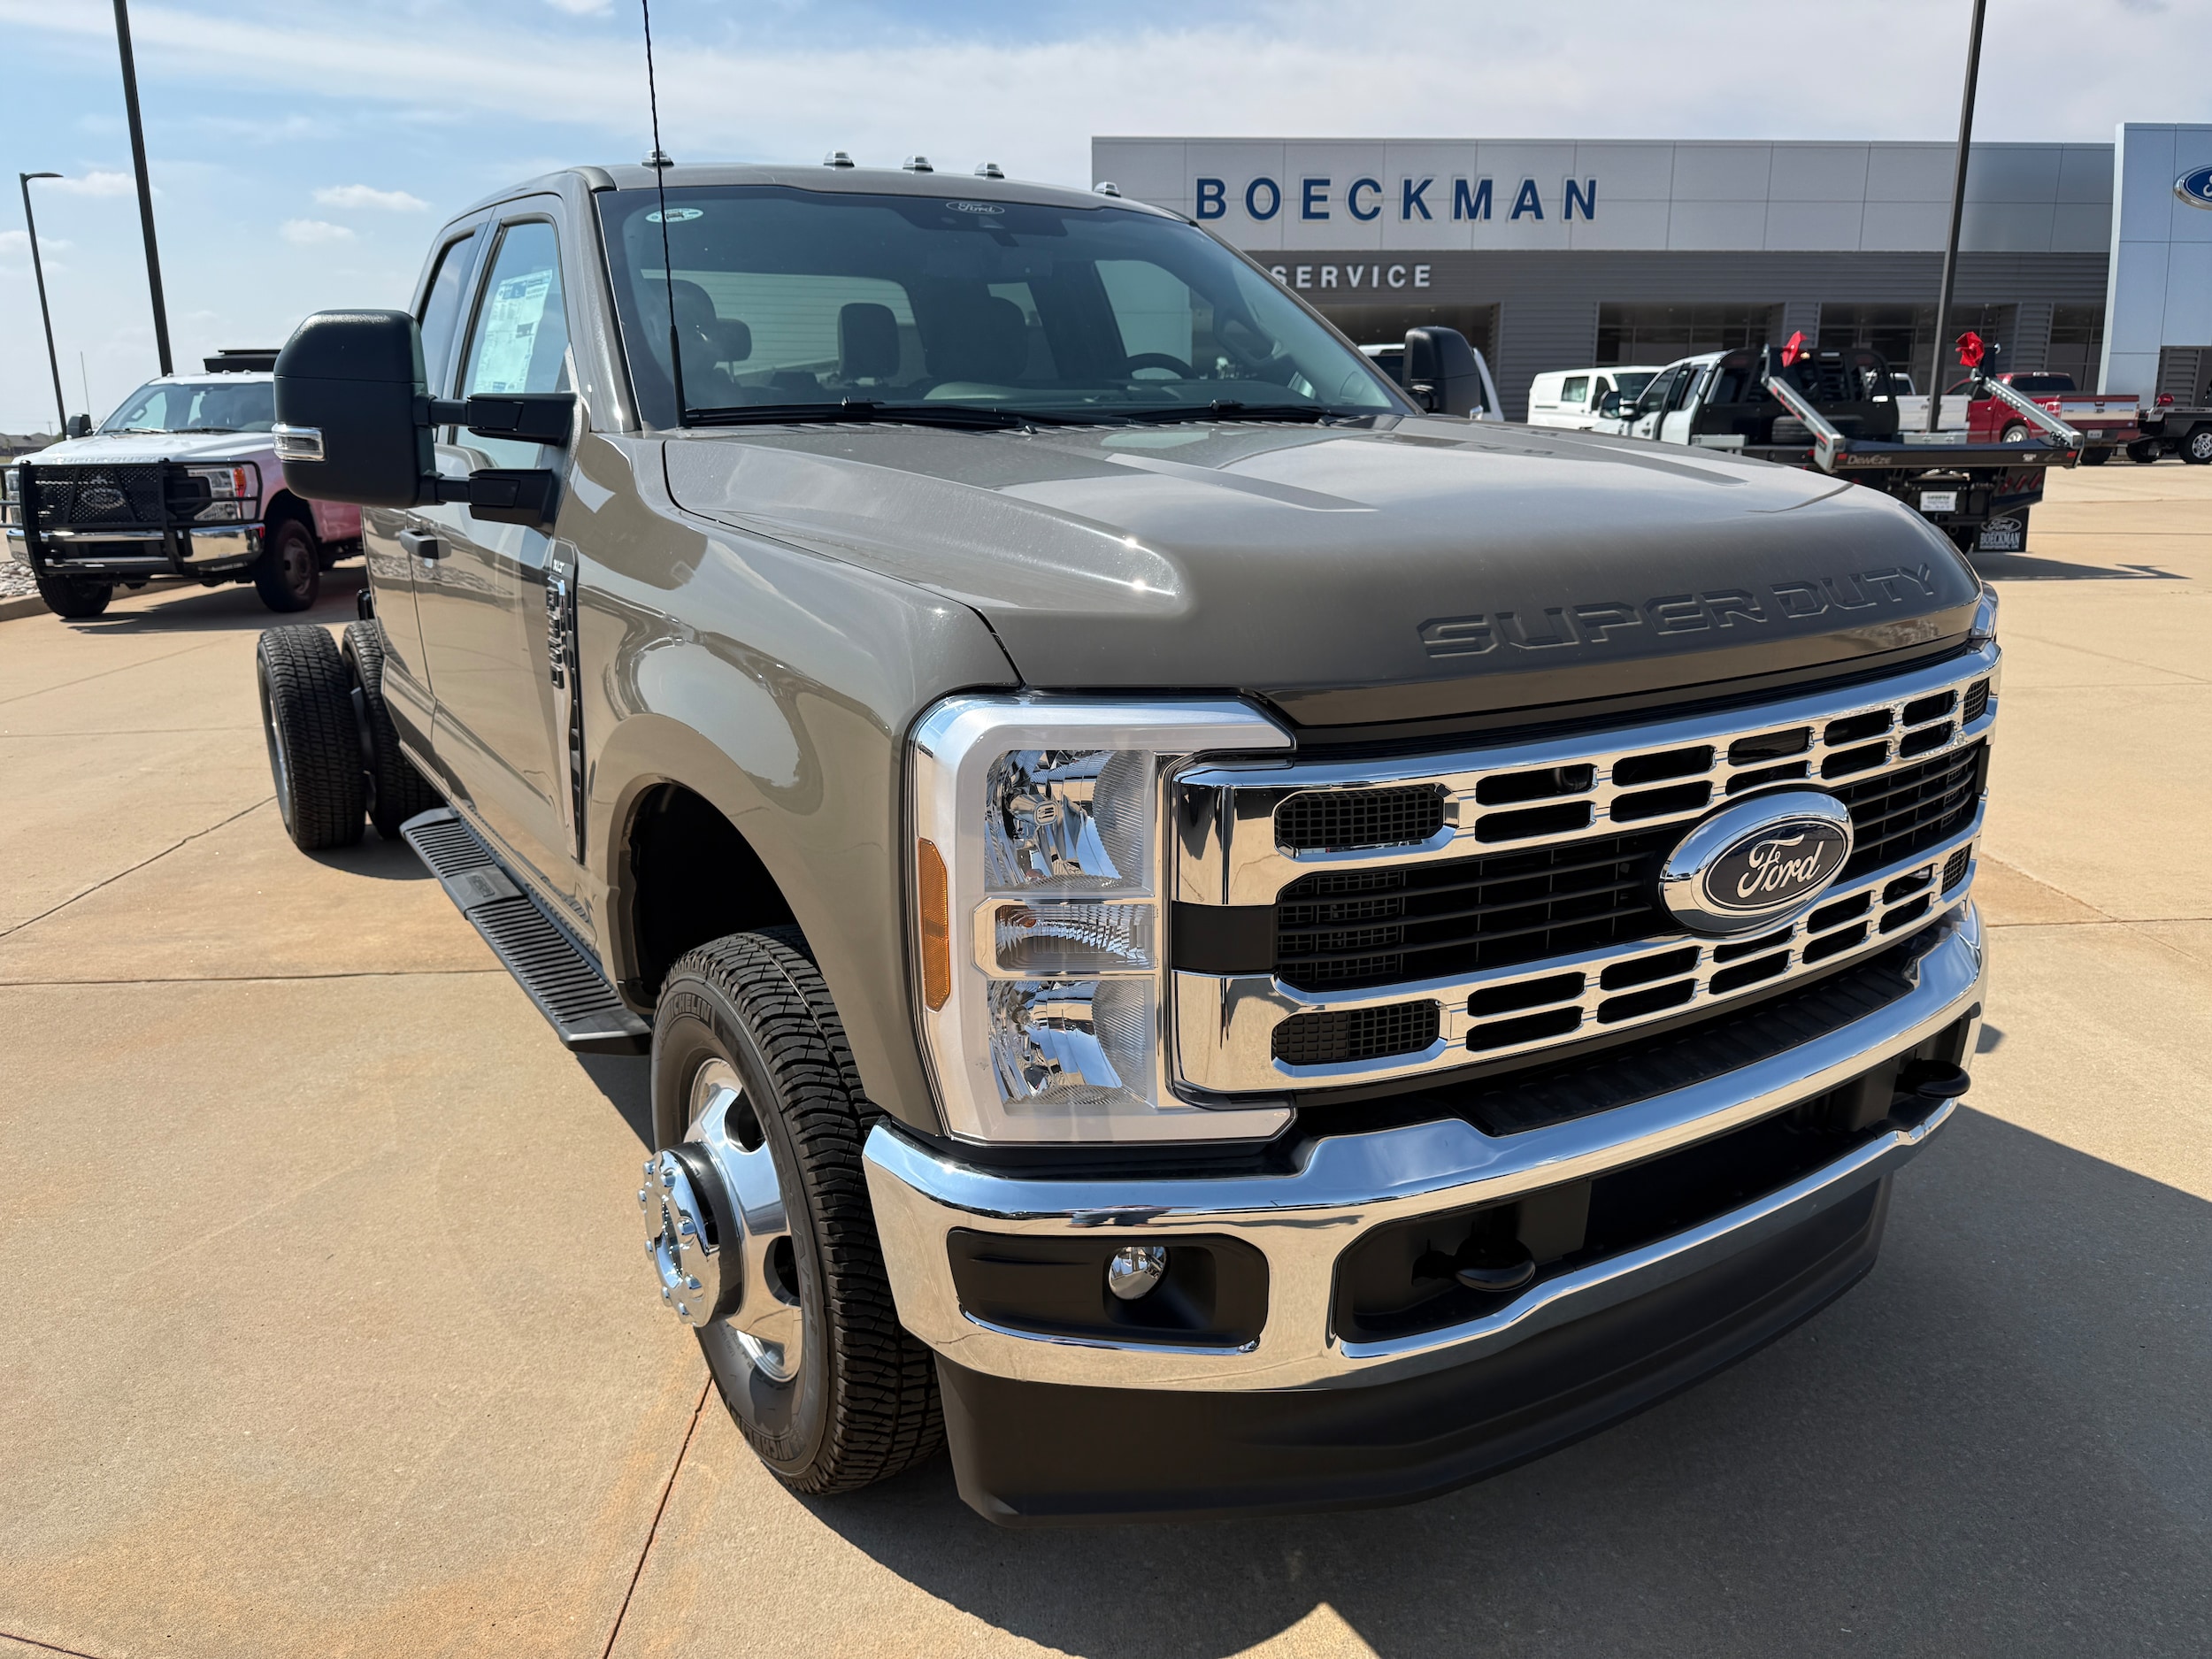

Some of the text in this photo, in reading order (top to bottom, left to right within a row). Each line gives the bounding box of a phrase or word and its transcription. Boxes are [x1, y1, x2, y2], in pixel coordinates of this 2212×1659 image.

[957, 203, 995, 213] Ford
[1195, 177, 1597, 220] BOECKMAN
[1270, 265, 1432, 288] SERVICE
[1980, 532, 2021, 546] BOECKMAN
[552, 558, 565, 574] XLT
[1416, 563, 1938, 658] SUPER DUTY
[1736, 833, 1825, 899] Ford
[662, 992, 713, 1032] MICHELIN
